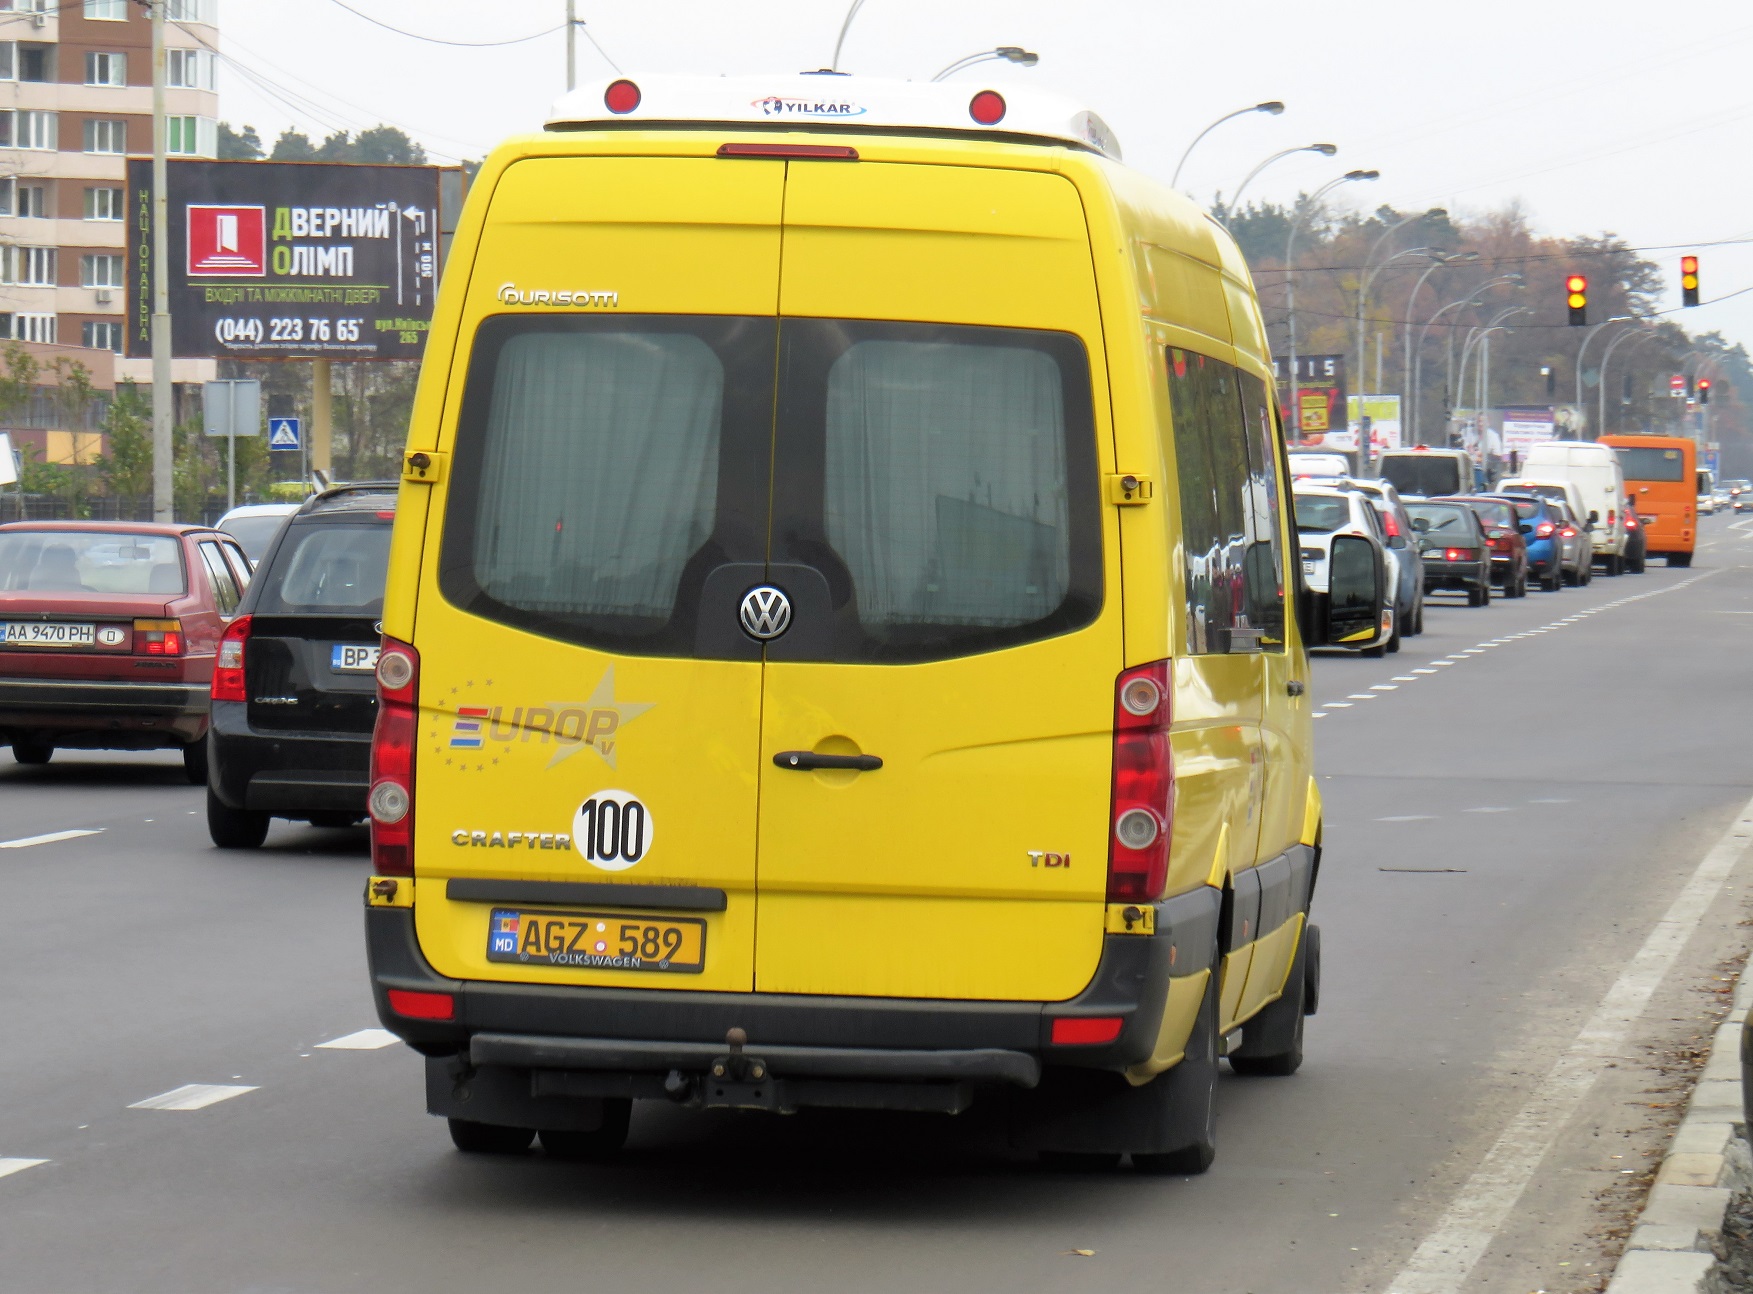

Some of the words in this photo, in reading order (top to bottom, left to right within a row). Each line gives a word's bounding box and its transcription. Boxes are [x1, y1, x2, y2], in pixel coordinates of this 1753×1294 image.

[785, 103, 851, 114] YILKAR
[272, 203, 390, 241] ДВЕРНИЙ
[139, 189, 149, 342] НАЦІОНАЛЬНА
[272, 245, 354, 277] ОЛІМП
[247, 288, 262, 303] ТА
[215, 318, 264, 344] (044)
[270, 318, 303, 341] 223
[309, 318, 331, 341] 76
[6, 625, 28, 640] AA
[32, 625, 66, 640] 9470
[69, 626, 91, 642] PH
[344, 648, 369, 667] BP
[451, 829, 572, 851] CRAFTER
[581, 798, 645, 863] 100
[1027, 850, 1071, 868] TDI
[494, 937, 514, 952] MD
[521, 919, 589, 955] AGZ
[618, 924, 683, 961] 589
[549, 952, 642, 968] VOLKSWAGEN
